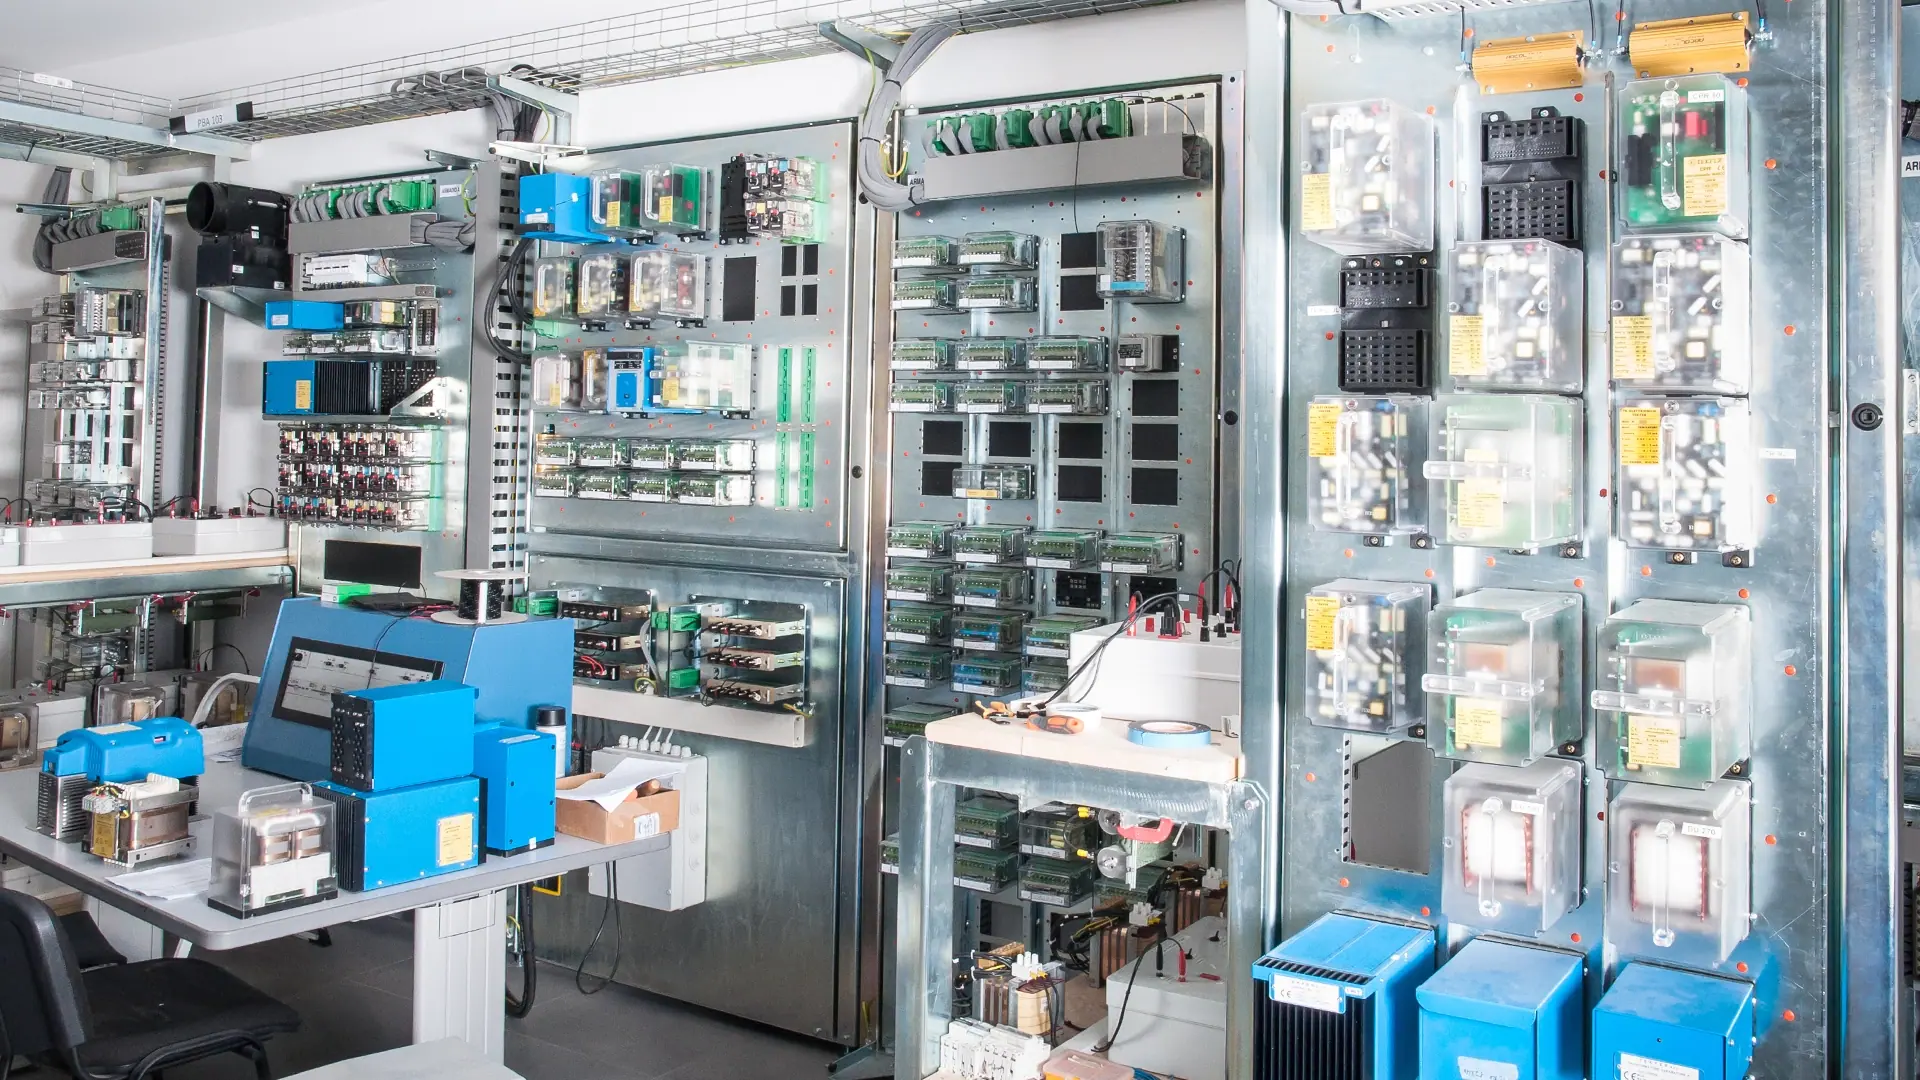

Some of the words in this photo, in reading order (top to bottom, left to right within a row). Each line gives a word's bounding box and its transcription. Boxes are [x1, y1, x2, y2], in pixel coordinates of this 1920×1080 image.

[197, 118, 210, 128] PBA
[212, 114, 223, 125] 103
[1905, 161, 1920, 171] AR
